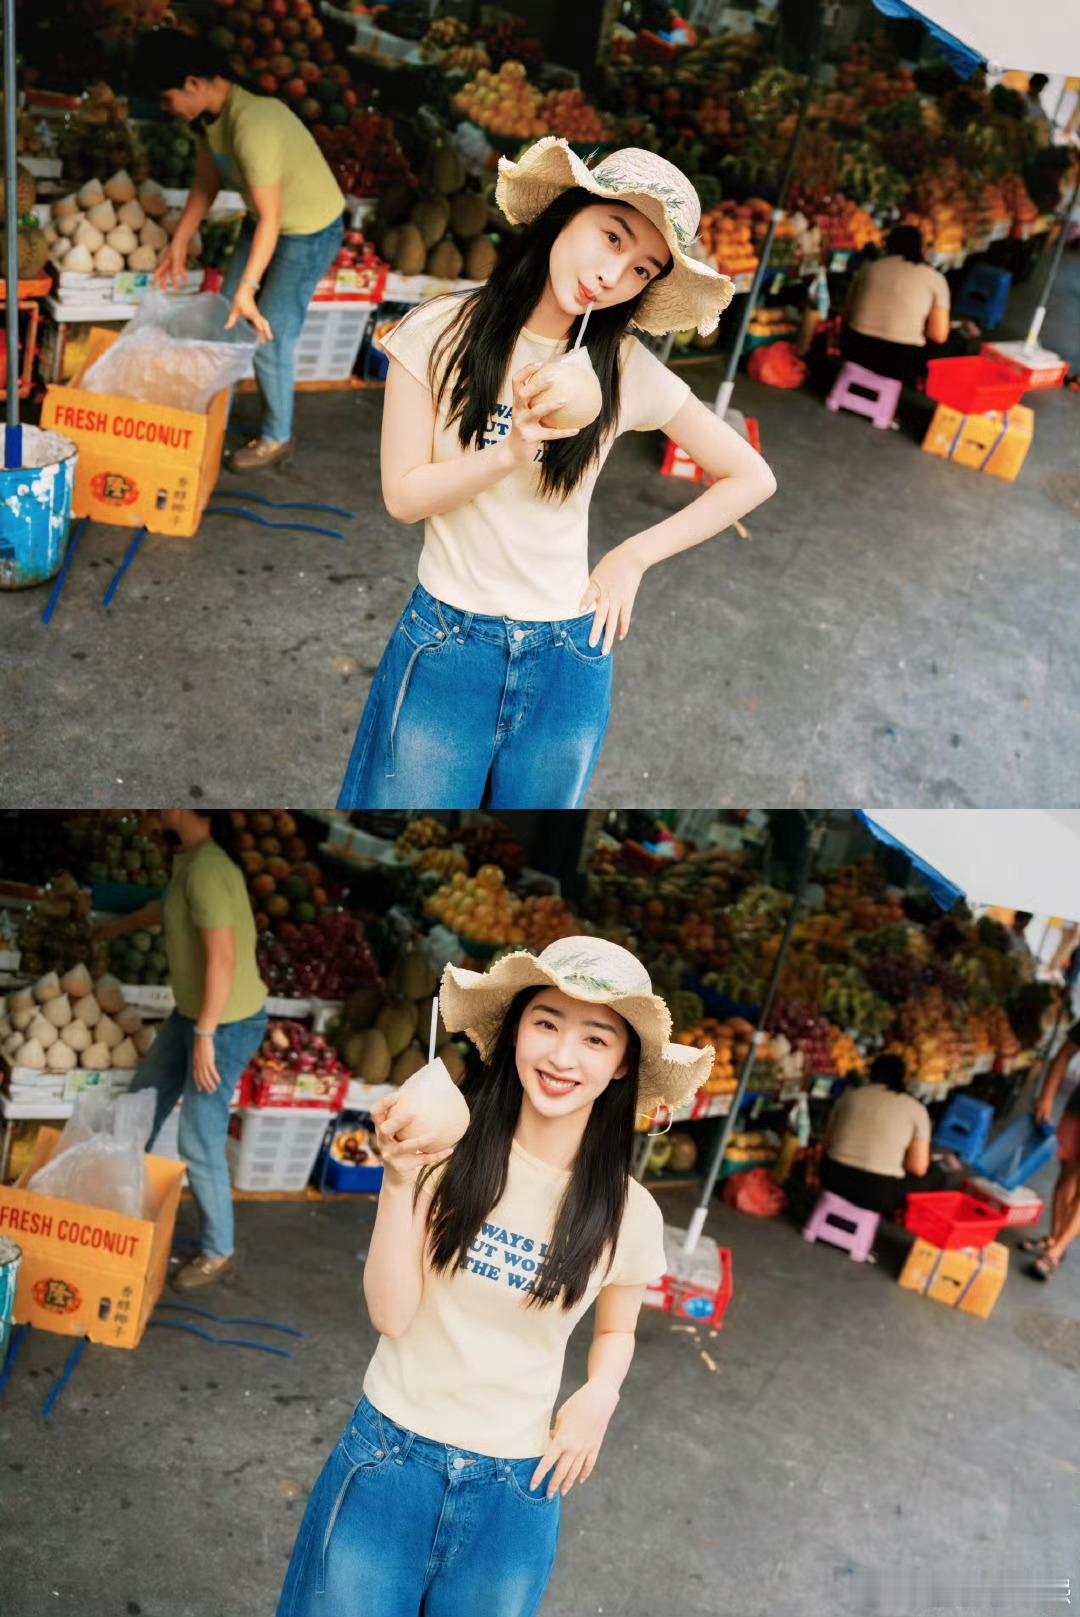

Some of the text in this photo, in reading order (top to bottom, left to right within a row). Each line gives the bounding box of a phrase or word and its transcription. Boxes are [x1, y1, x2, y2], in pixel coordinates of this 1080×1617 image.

[54, 404, 193, 449] FRESH COCONUT
[0, 1206, 139, 1257] FRESH COCONUT
[461, 1256, 501, 1281] THE
